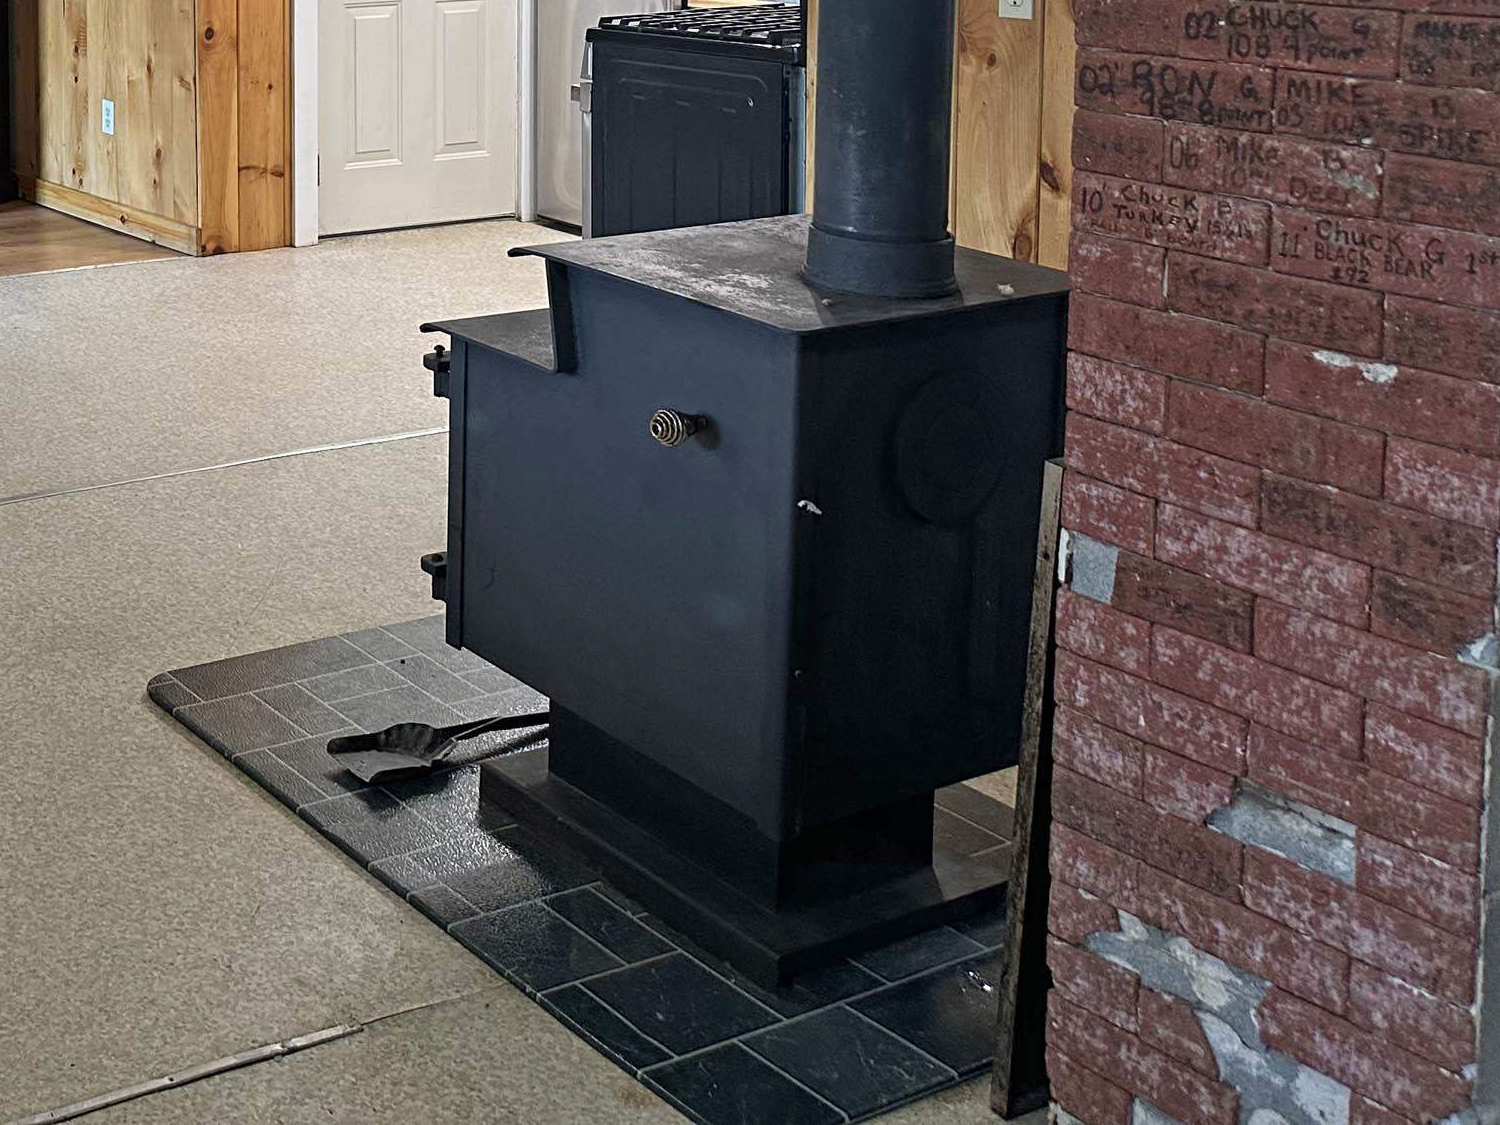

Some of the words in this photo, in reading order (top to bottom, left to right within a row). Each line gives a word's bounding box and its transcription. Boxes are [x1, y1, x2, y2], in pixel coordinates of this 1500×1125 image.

[1225, 5, 1320, 34] CHUCK
[1226, 32, 1272, 59] 108
[1132, 59, 1219, 97] RON
[1238, 75, 1261, 104] G
[1286, 77, 1375, 106] MIKE
[1120, 184, 1200, 212] Chuck
[1314, 218, 1405, 257] Chuck
[1424, 237, 1447, 266] G
[1313, 240, 1374, 268] BLACK
[1383, 254, 1438, 283] BEAR
